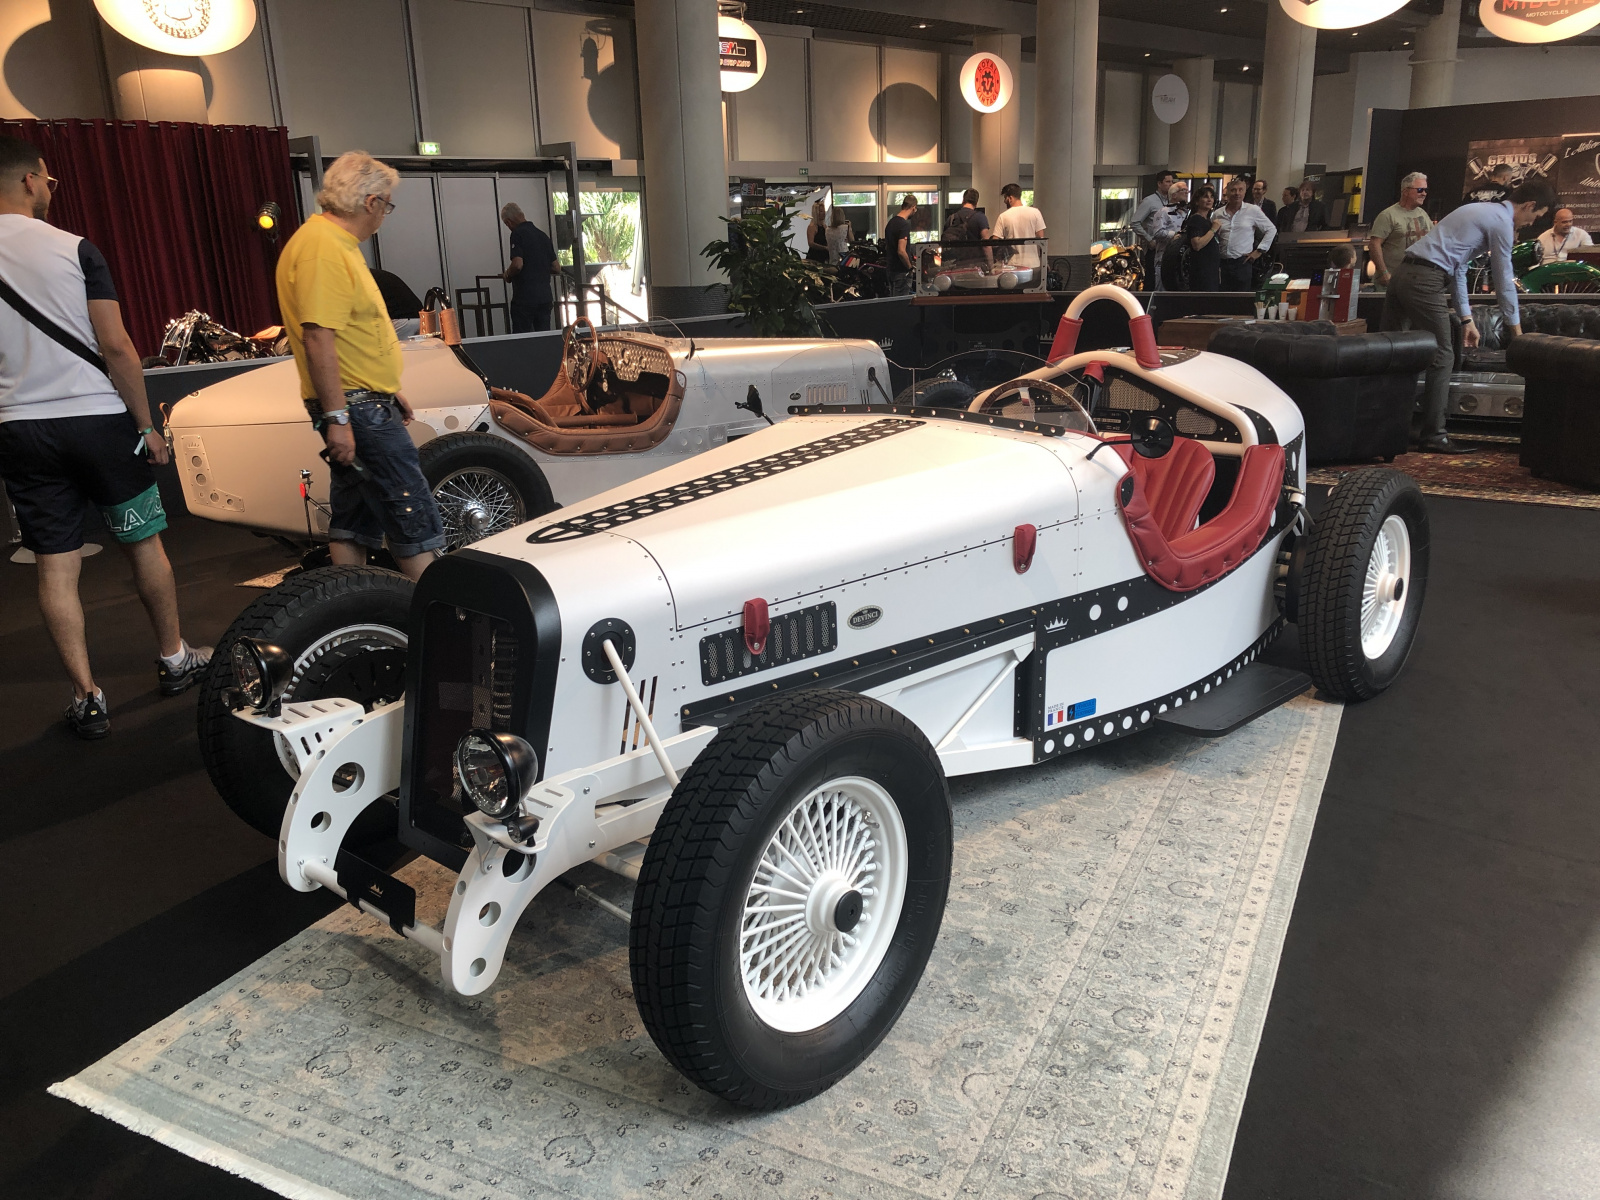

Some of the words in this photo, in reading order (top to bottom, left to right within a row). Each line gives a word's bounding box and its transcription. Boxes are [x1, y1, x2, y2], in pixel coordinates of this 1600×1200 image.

[1502, 0, 1596, 12] MIDU
[1525, 9, 1570, 18] MOTOCYCLES
[977, 60, 997, 73] ROYAL
[977, 87, 999, 105] VINTAGE
[1487, 152, 1538, 166] GENIUS
[852, 611, 878, 624] DEVINCI
